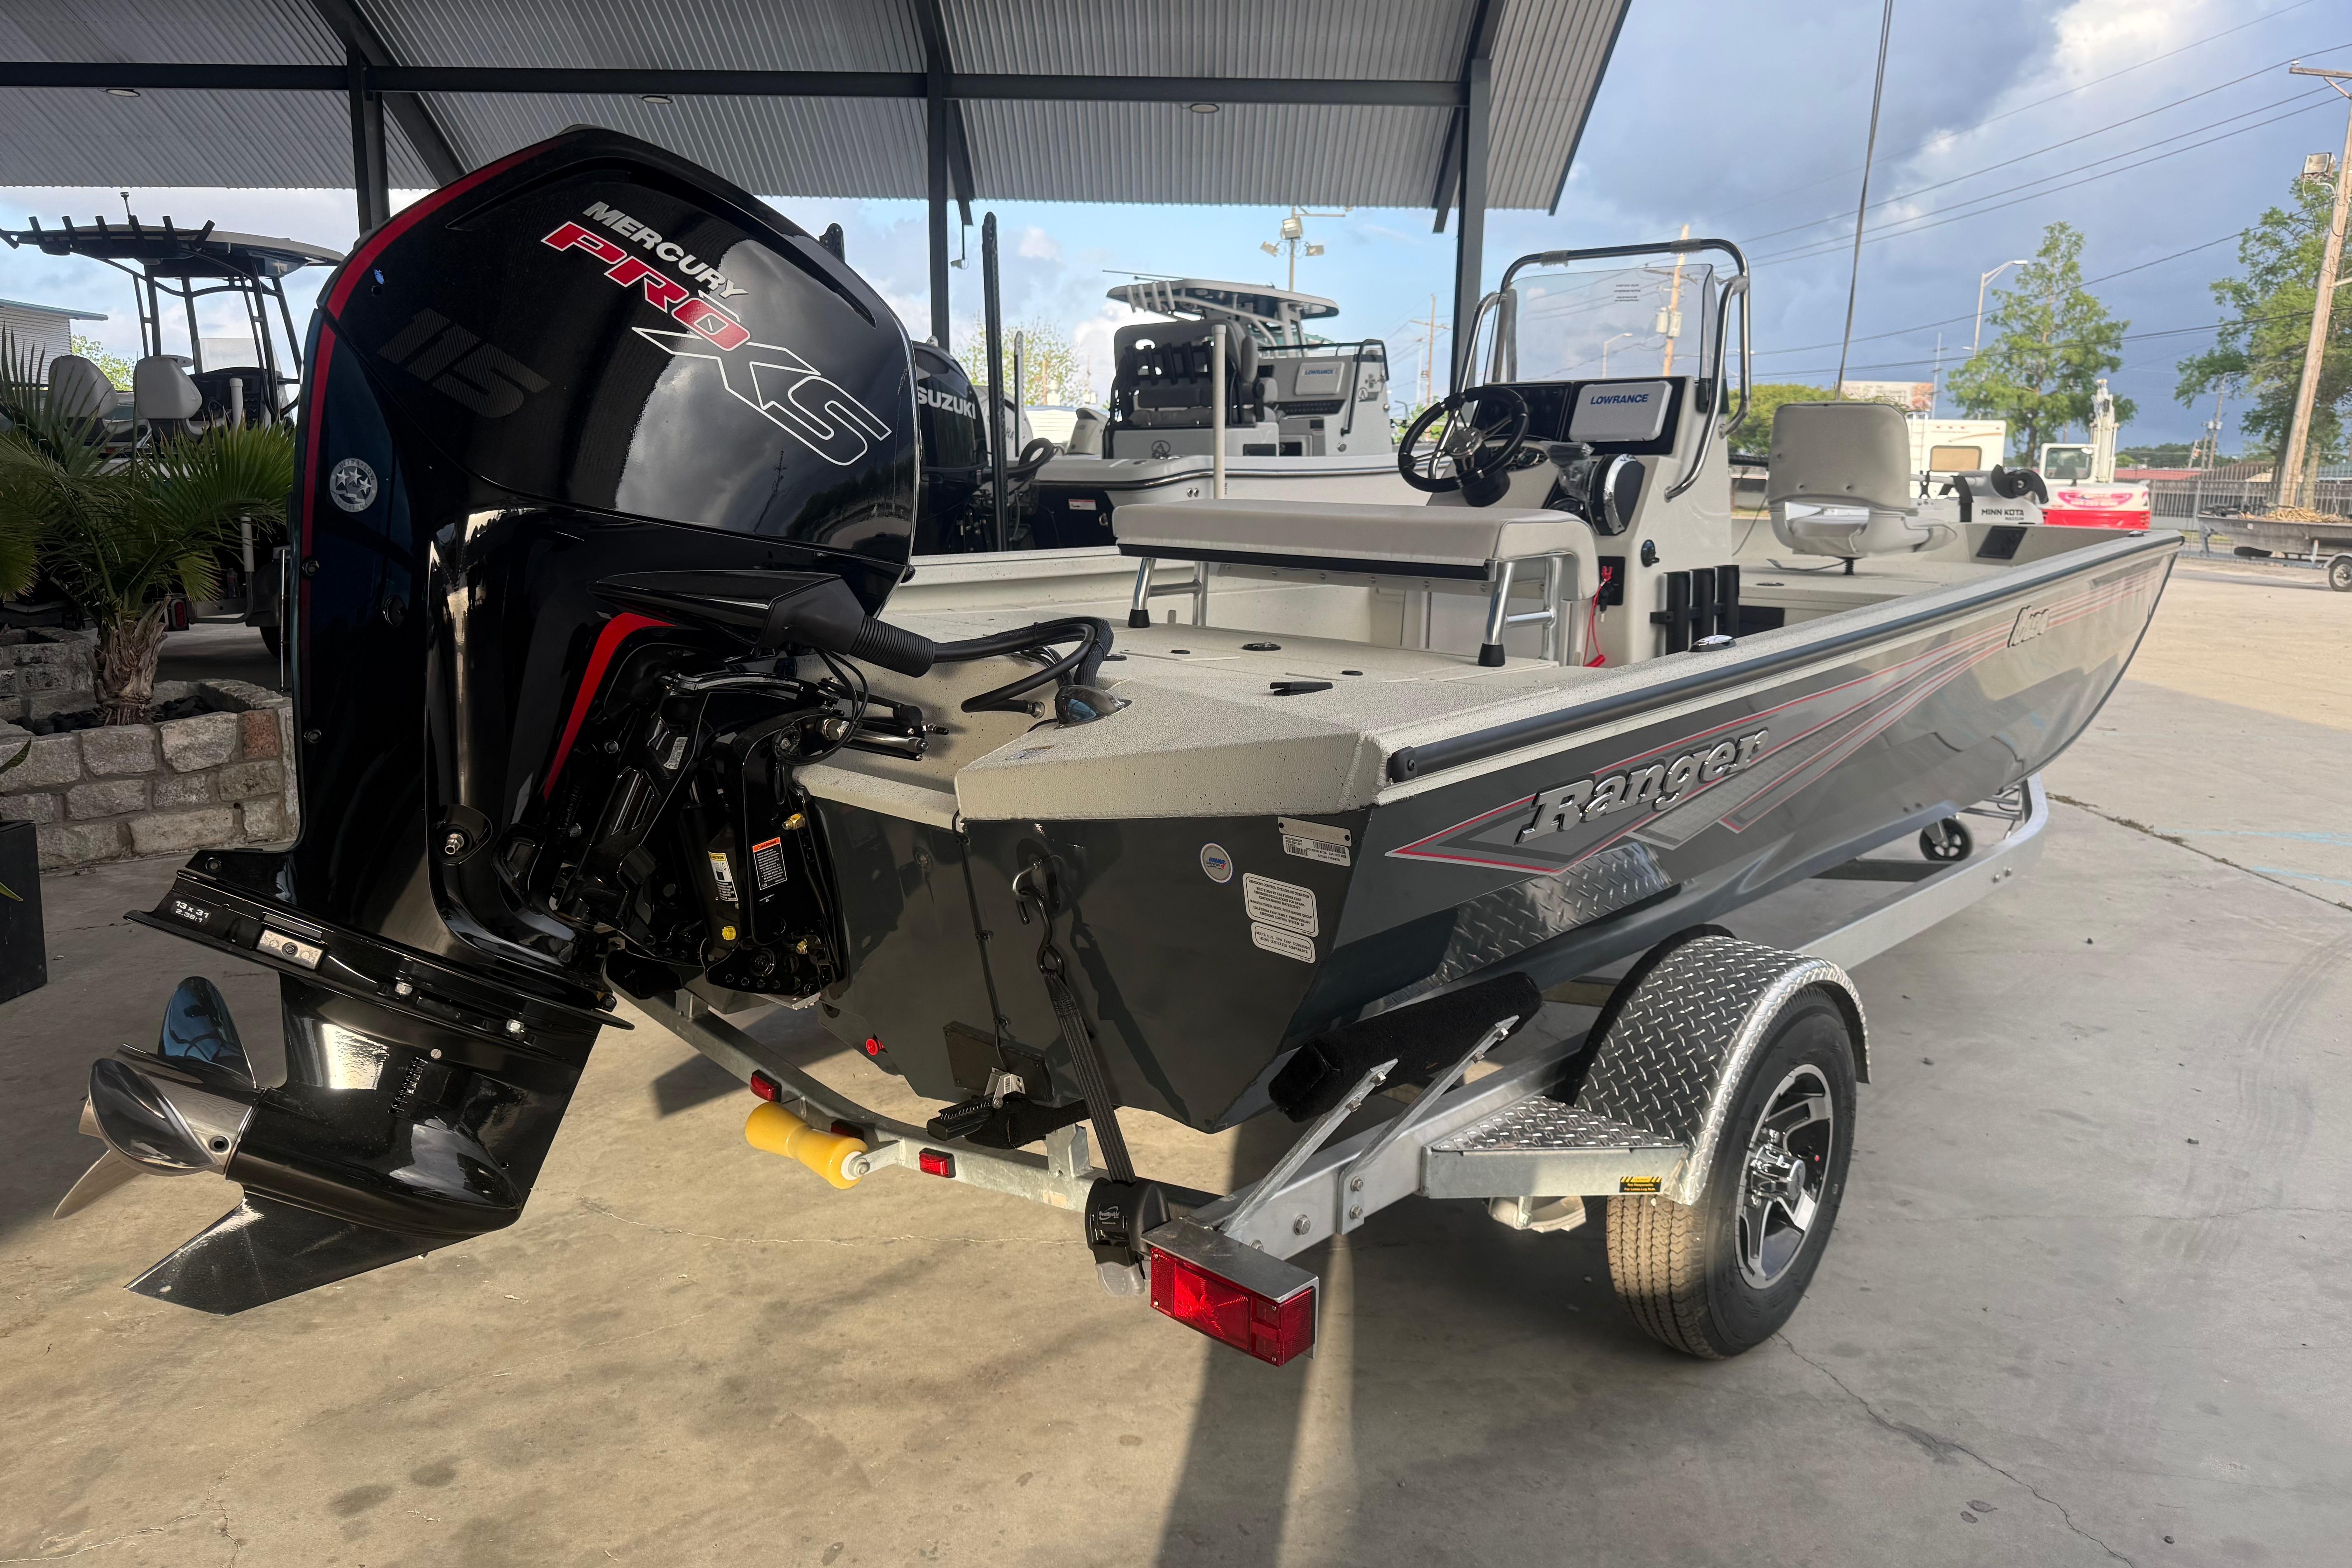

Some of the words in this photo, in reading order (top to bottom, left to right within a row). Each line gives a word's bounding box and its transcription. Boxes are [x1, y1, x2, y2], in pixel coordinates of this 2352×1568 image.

[541, 221, 750, 351] PRO
[582, 201, 749, 299] MERCURY
[376, 307, 551, 418] 115
[631, 305, 891, 466] XS
[917, 386, 976, 420] SUZUKI
[1590, 393, 1650, 405] LOWRANCE
[1515, 727, 1769, 844] Ranger
[176, 901, 188, 909] 13
[196, 909, 209, 918] 31
